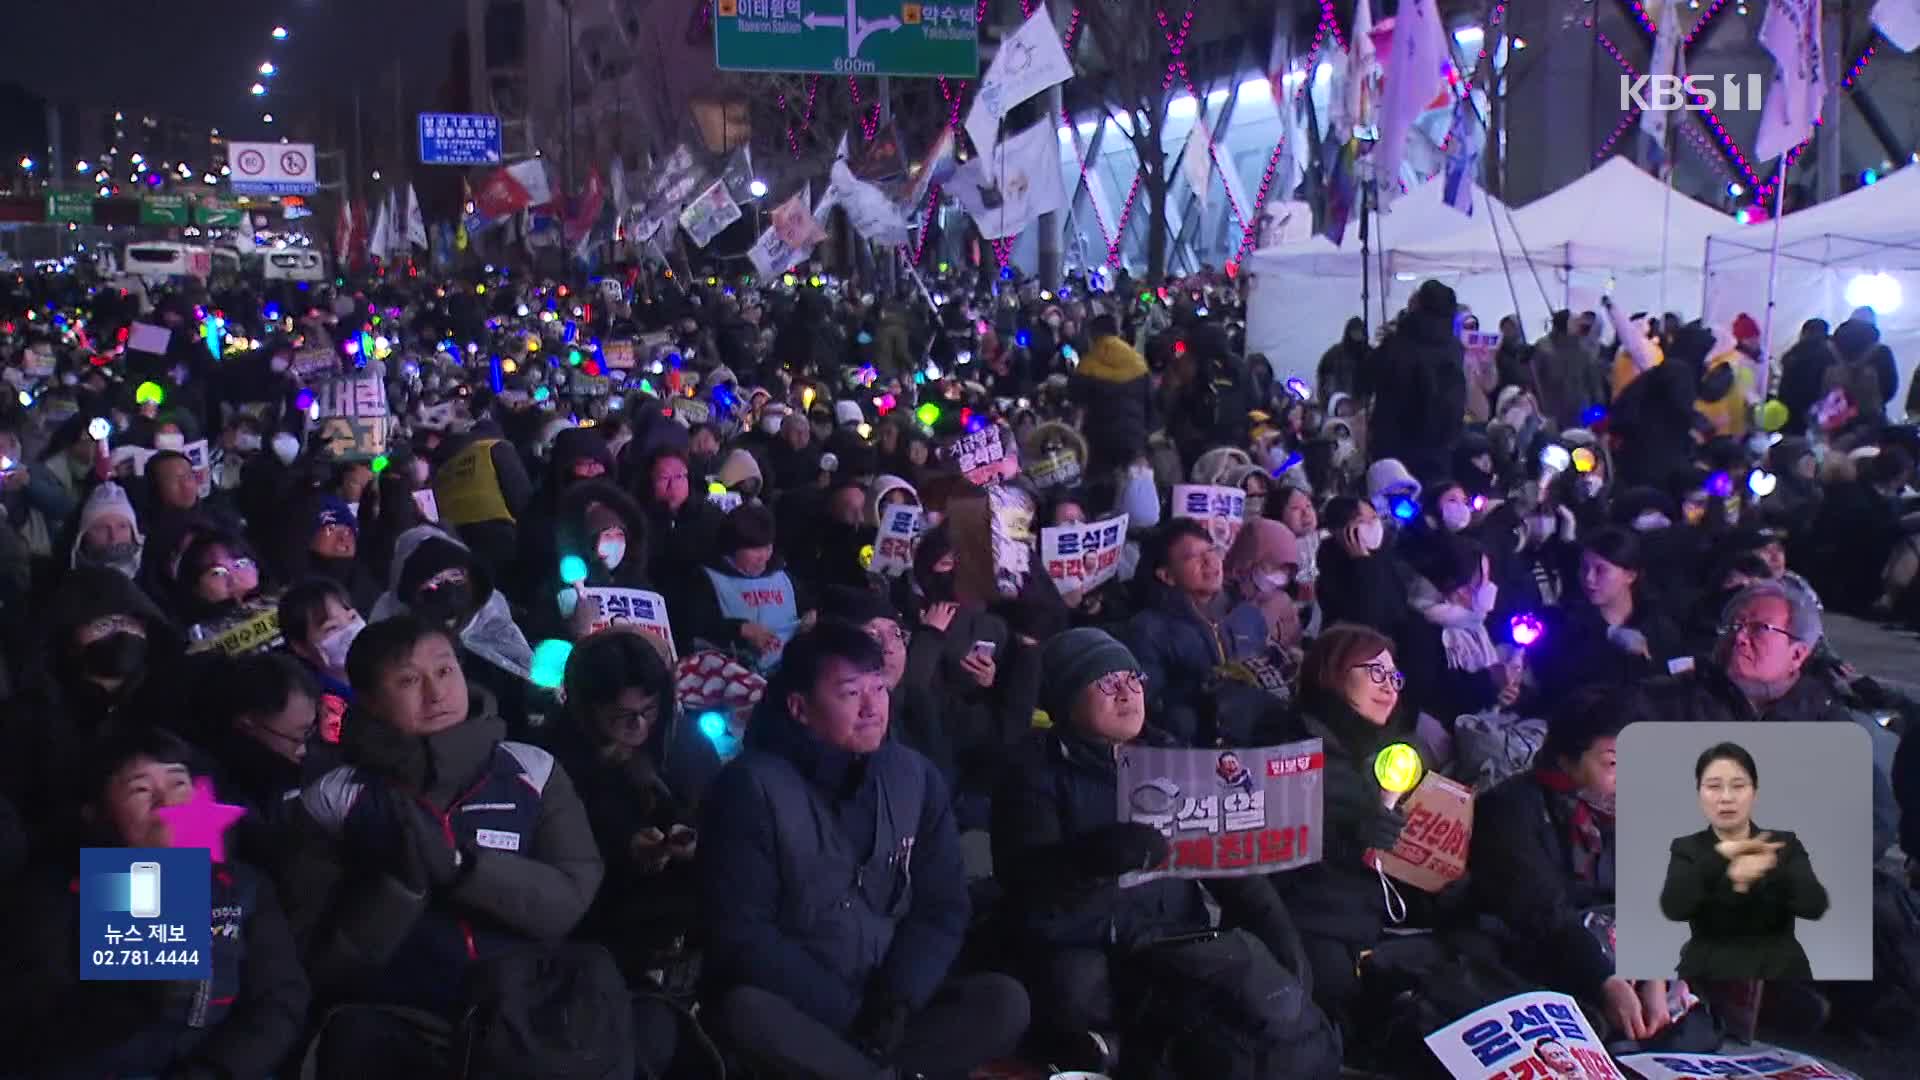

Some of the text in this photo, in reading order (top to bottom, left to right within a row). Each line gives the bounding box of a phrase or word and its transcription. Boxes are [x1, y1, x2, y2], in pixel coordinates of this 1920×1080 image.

[922, 5, 976, 27] 약수역
[834, 58, 875, 72] 600m
[1058, 525, 1119, 555] 윤석열
[1462, 1003, 1588, 1067] 윤석열
